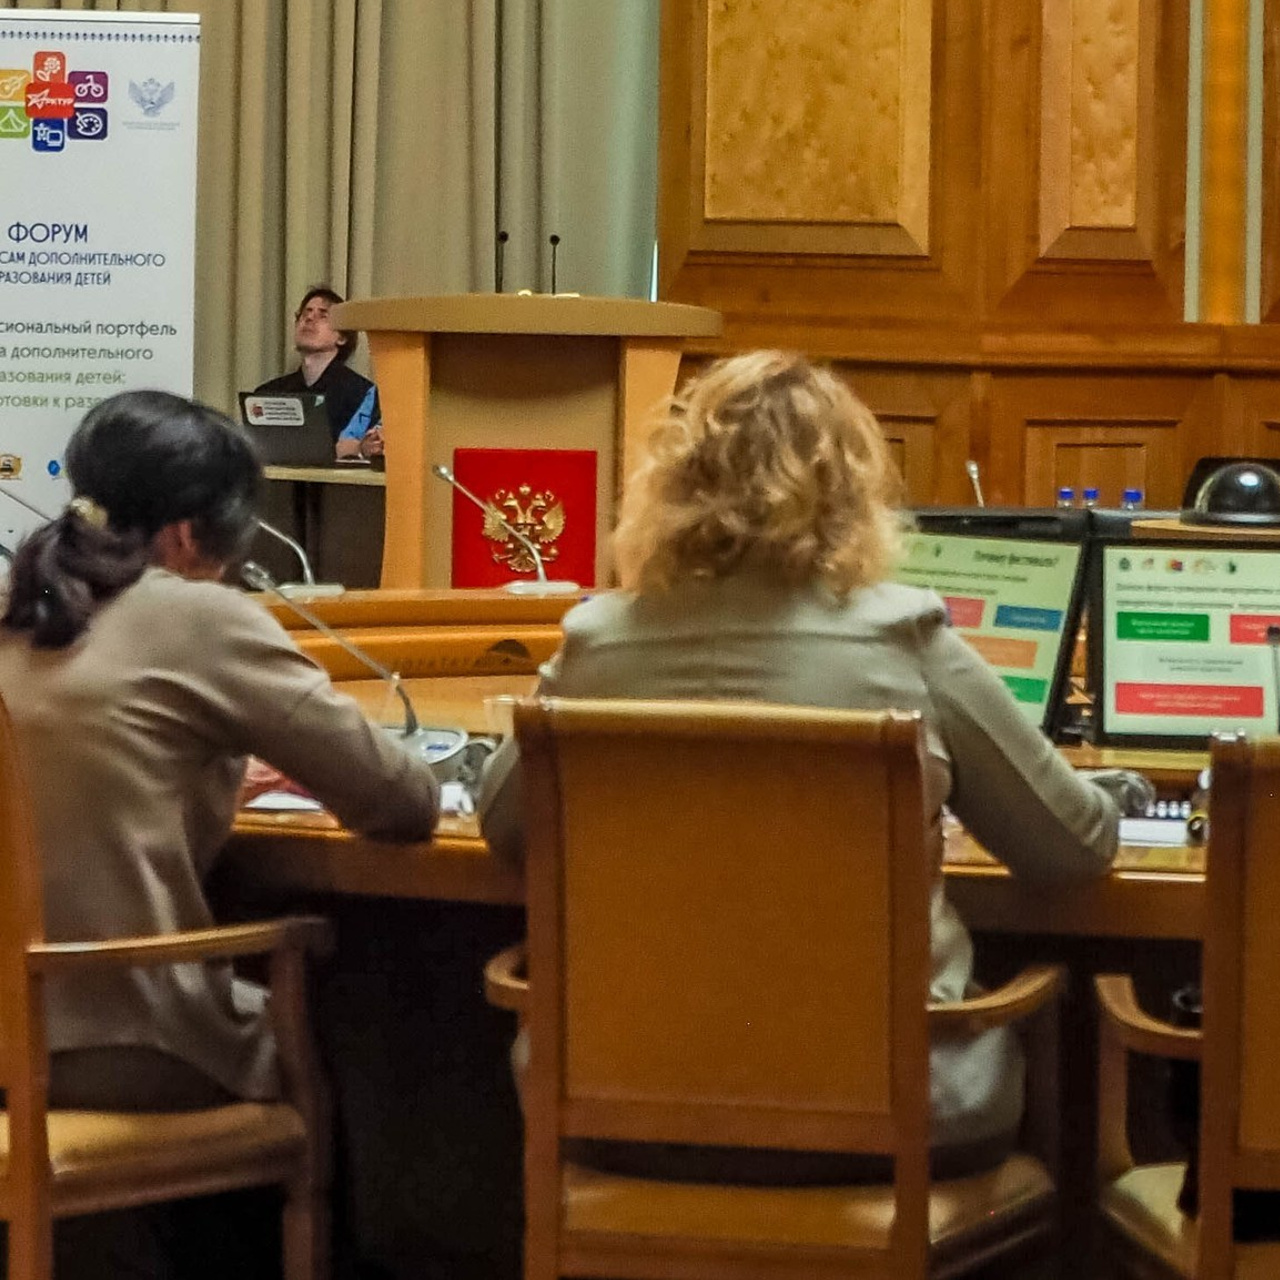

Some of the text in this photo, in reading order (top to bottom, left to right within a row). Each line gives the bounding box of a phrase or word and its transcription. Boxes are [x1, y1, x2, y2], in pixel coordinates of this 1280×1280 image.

[8, 222, 87, 243] ФОРУМ
[28, 252, 165, 266] ДОПОЛНИТЕЛЬНОГО
[74, 271, 111, 286] ДЕТЕЙ
[96, 321, 177, 338] портфель
[11, 346, 154, 361] дополнительного
[52, 396, 61, 408] к
